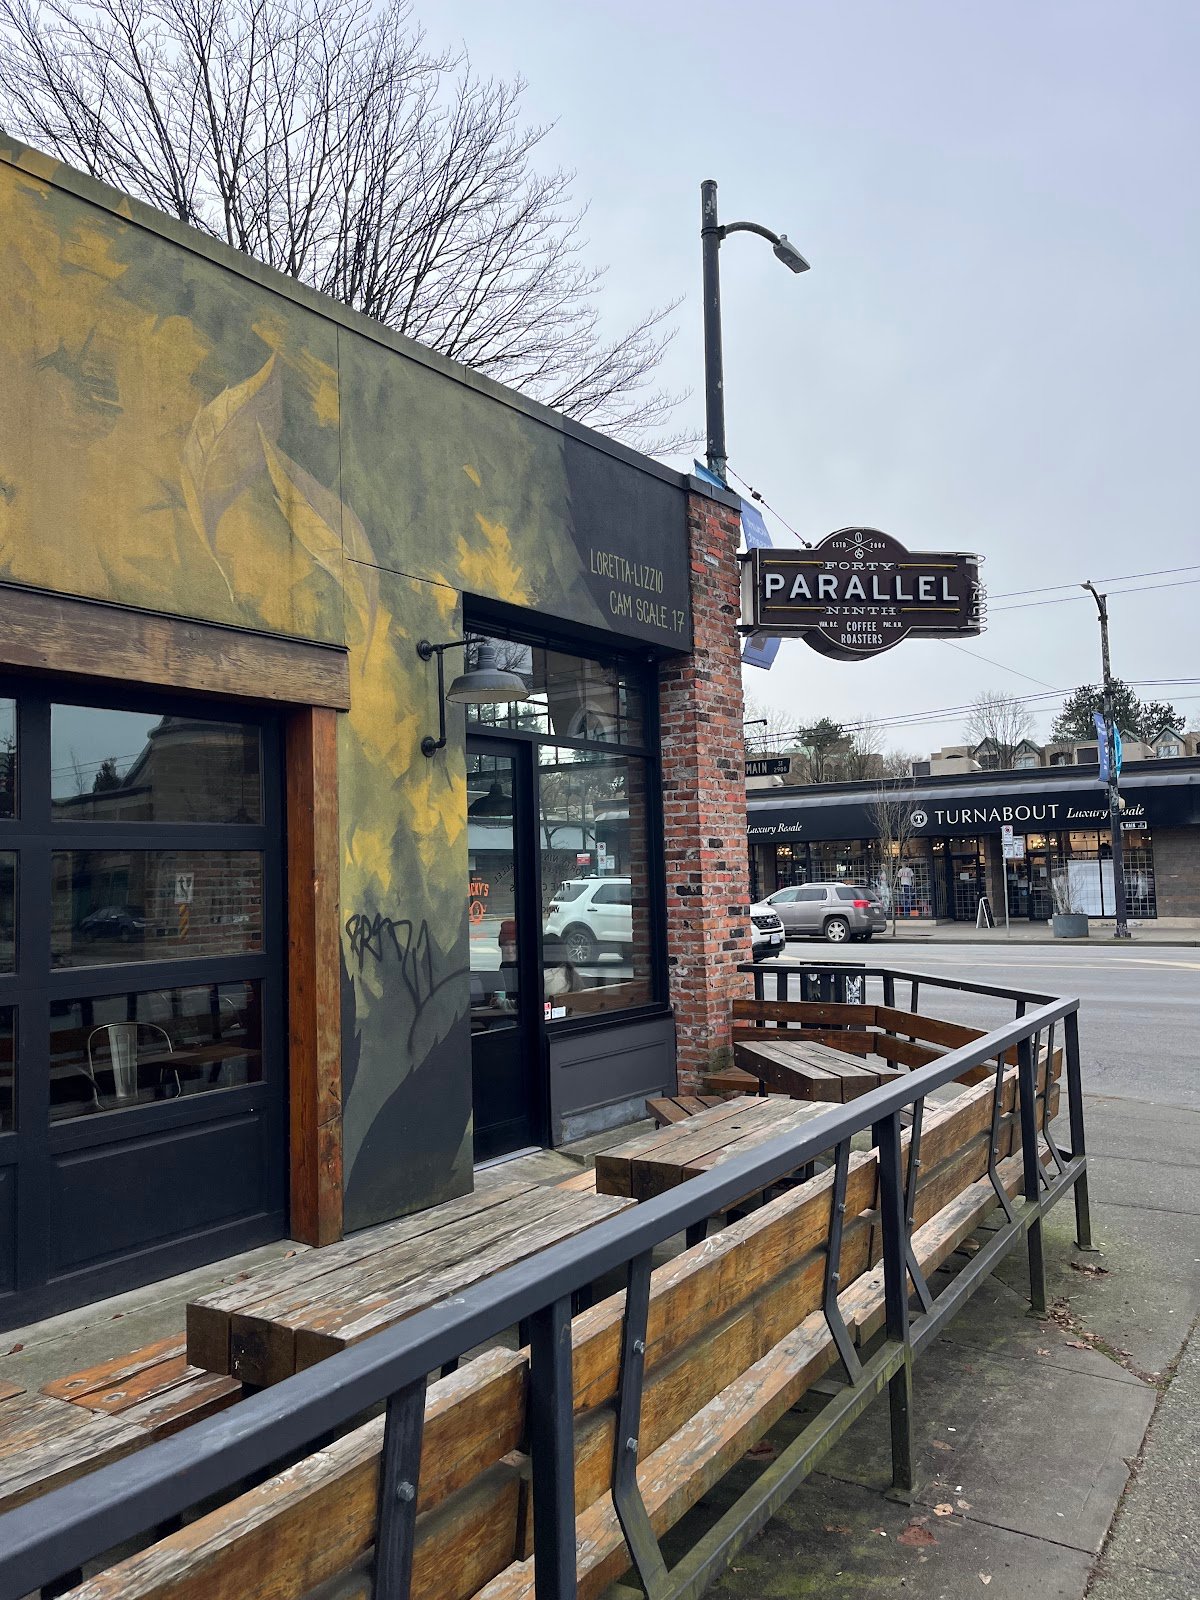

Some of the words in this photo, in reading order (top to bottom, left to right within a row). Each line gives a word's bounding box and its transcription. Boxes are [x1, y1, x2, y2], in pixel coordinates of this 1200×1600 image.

[824, 561, 895, 571] FORTY
[765, 573, 960, 601] PARALLEL
[609, 590, 633, 618] CAM
[825, 606, 897, 616] NINTH
[846, 621, 877, 632] COFFEE
[840, 633, 883, 644] ROASTERS
[746, 762, 768, 775] MAIN
[934, 804, 1059, 825] TURNABOUT
[1066, 807, 1109, 820] Luxury
[746, 824, 777, 835] Luxury
[777, 821, 803, 833] Resale
